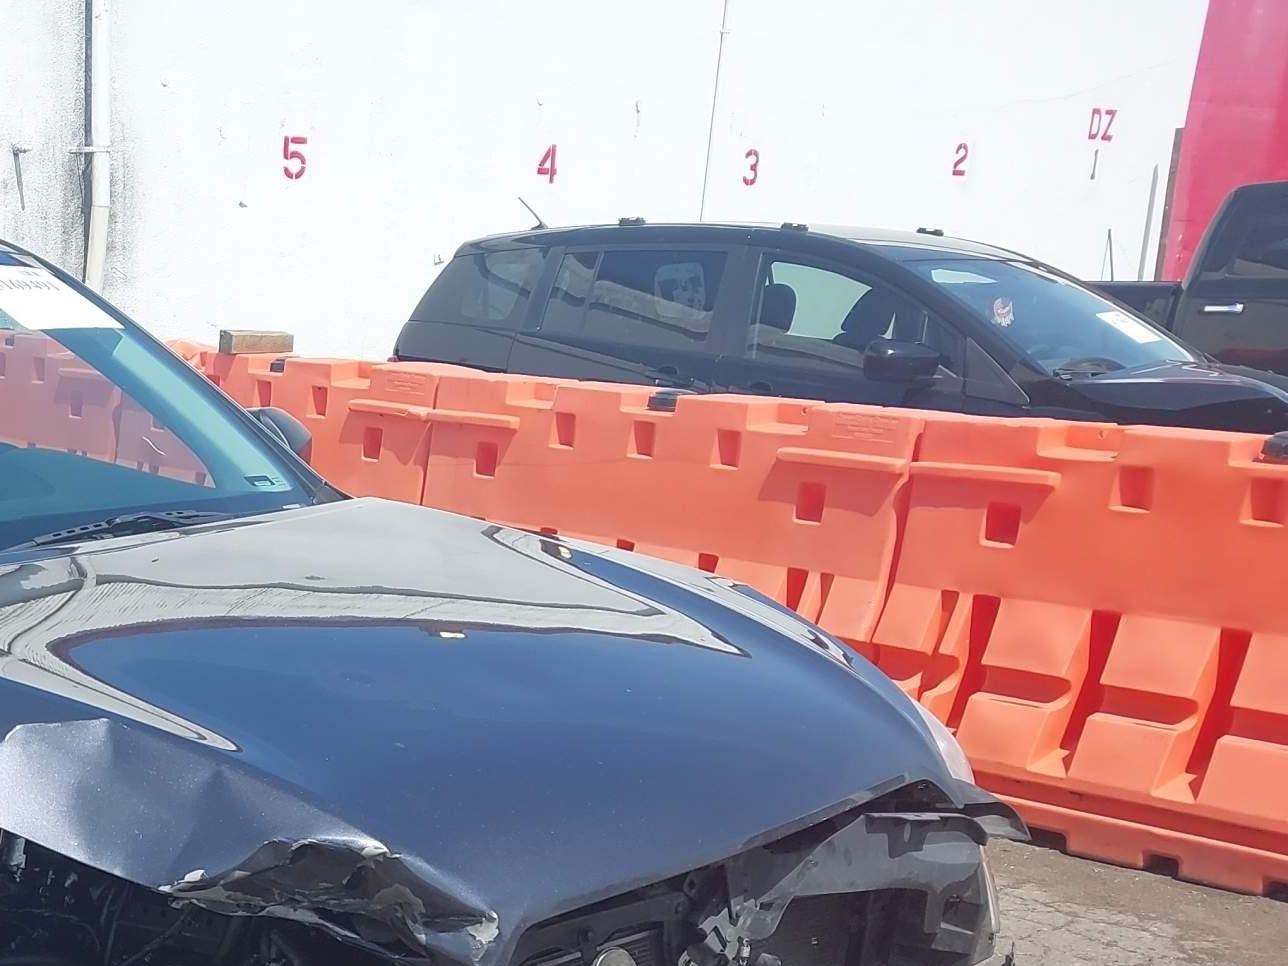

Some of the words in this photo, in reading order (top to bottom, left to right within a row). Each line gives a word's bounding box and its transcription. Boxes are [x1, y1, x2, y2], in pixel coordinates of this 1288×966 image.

[1088, 107, 1117, 142] DZ
[282, 135, 308, 180] 5
[536, 144, 557, 184] 4
[742, 148, 759, 185] 3
[951, 142, 969, 177] 2
